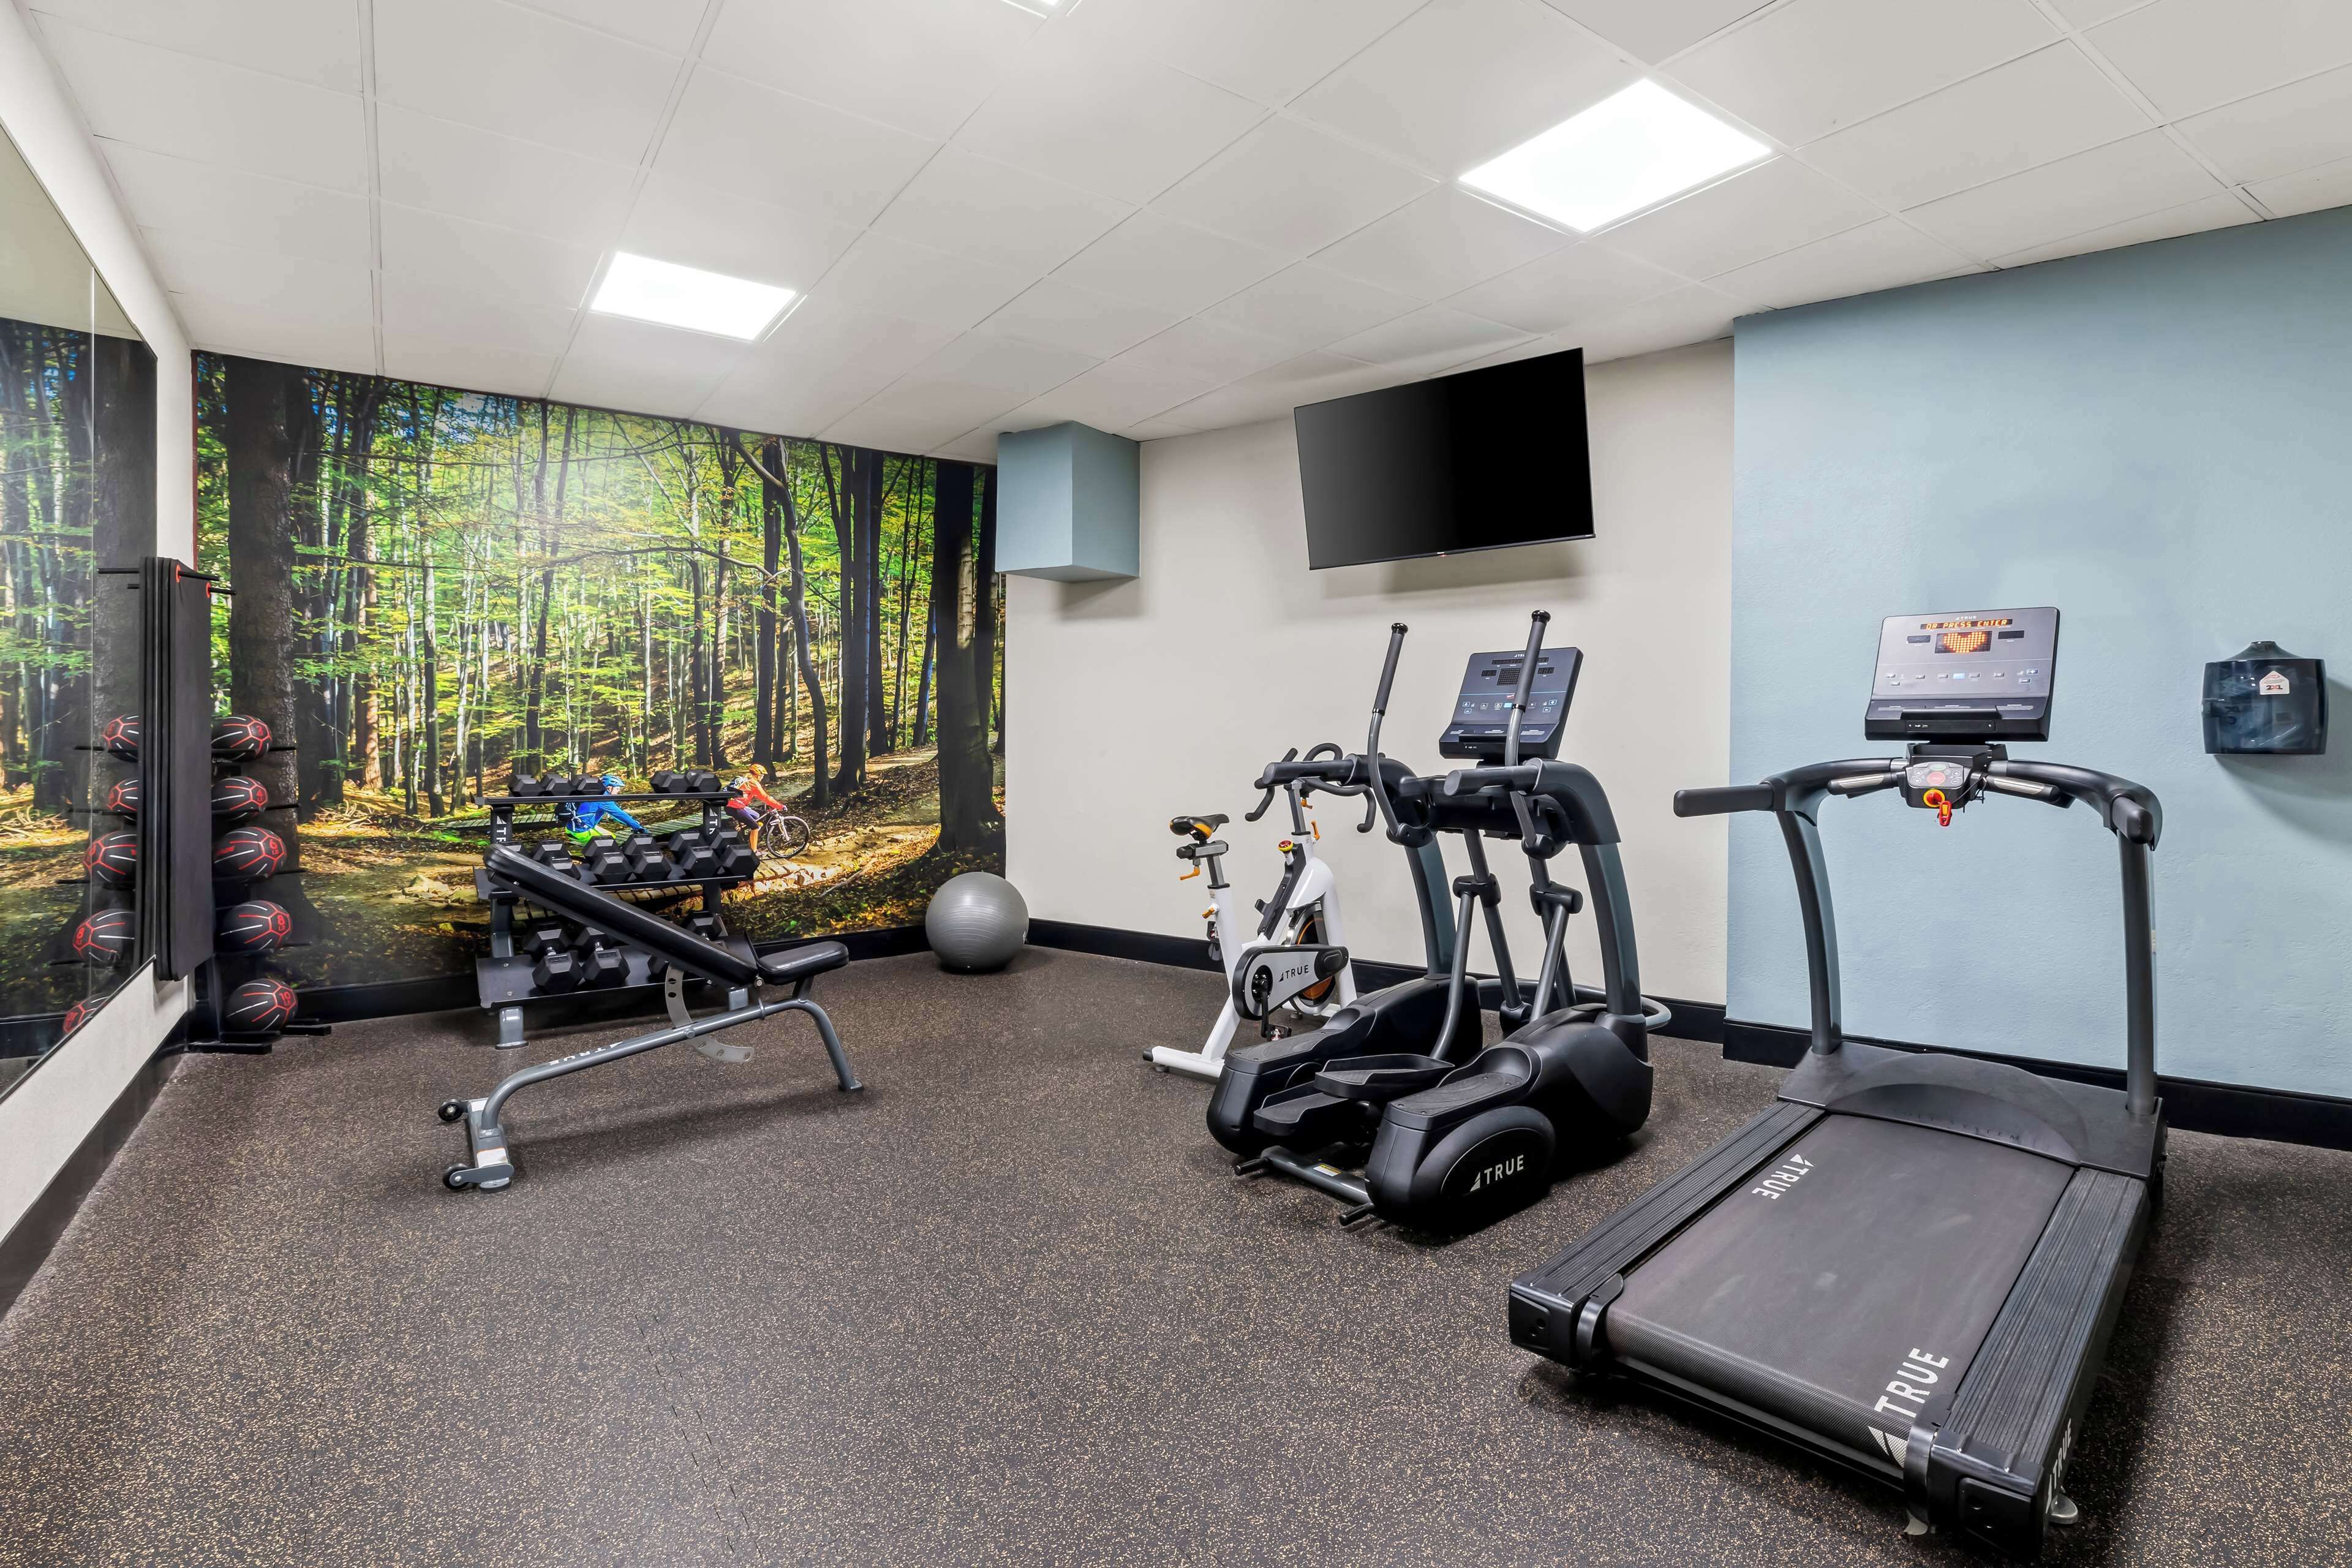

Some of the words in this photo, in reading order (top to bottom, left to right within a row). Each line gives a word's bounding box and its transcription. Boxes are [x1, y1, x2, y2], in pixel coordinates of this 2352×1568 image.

[270, 839, 278, 849] 6
[277, 914, 285, 925] 8
[1285, 964, 1309, 979] TRUE
[279, 991, 291, 1001] 10
[548, 1047, 606, 1066] TRUE
[1484, 1154, 1524, 1185] TRUE
[1751, 1164, 1809, 1199] TRUE
[1874, 1348, 1950, 1418] TRUE
[2052, 1418, 2071, 1490] TRUE
